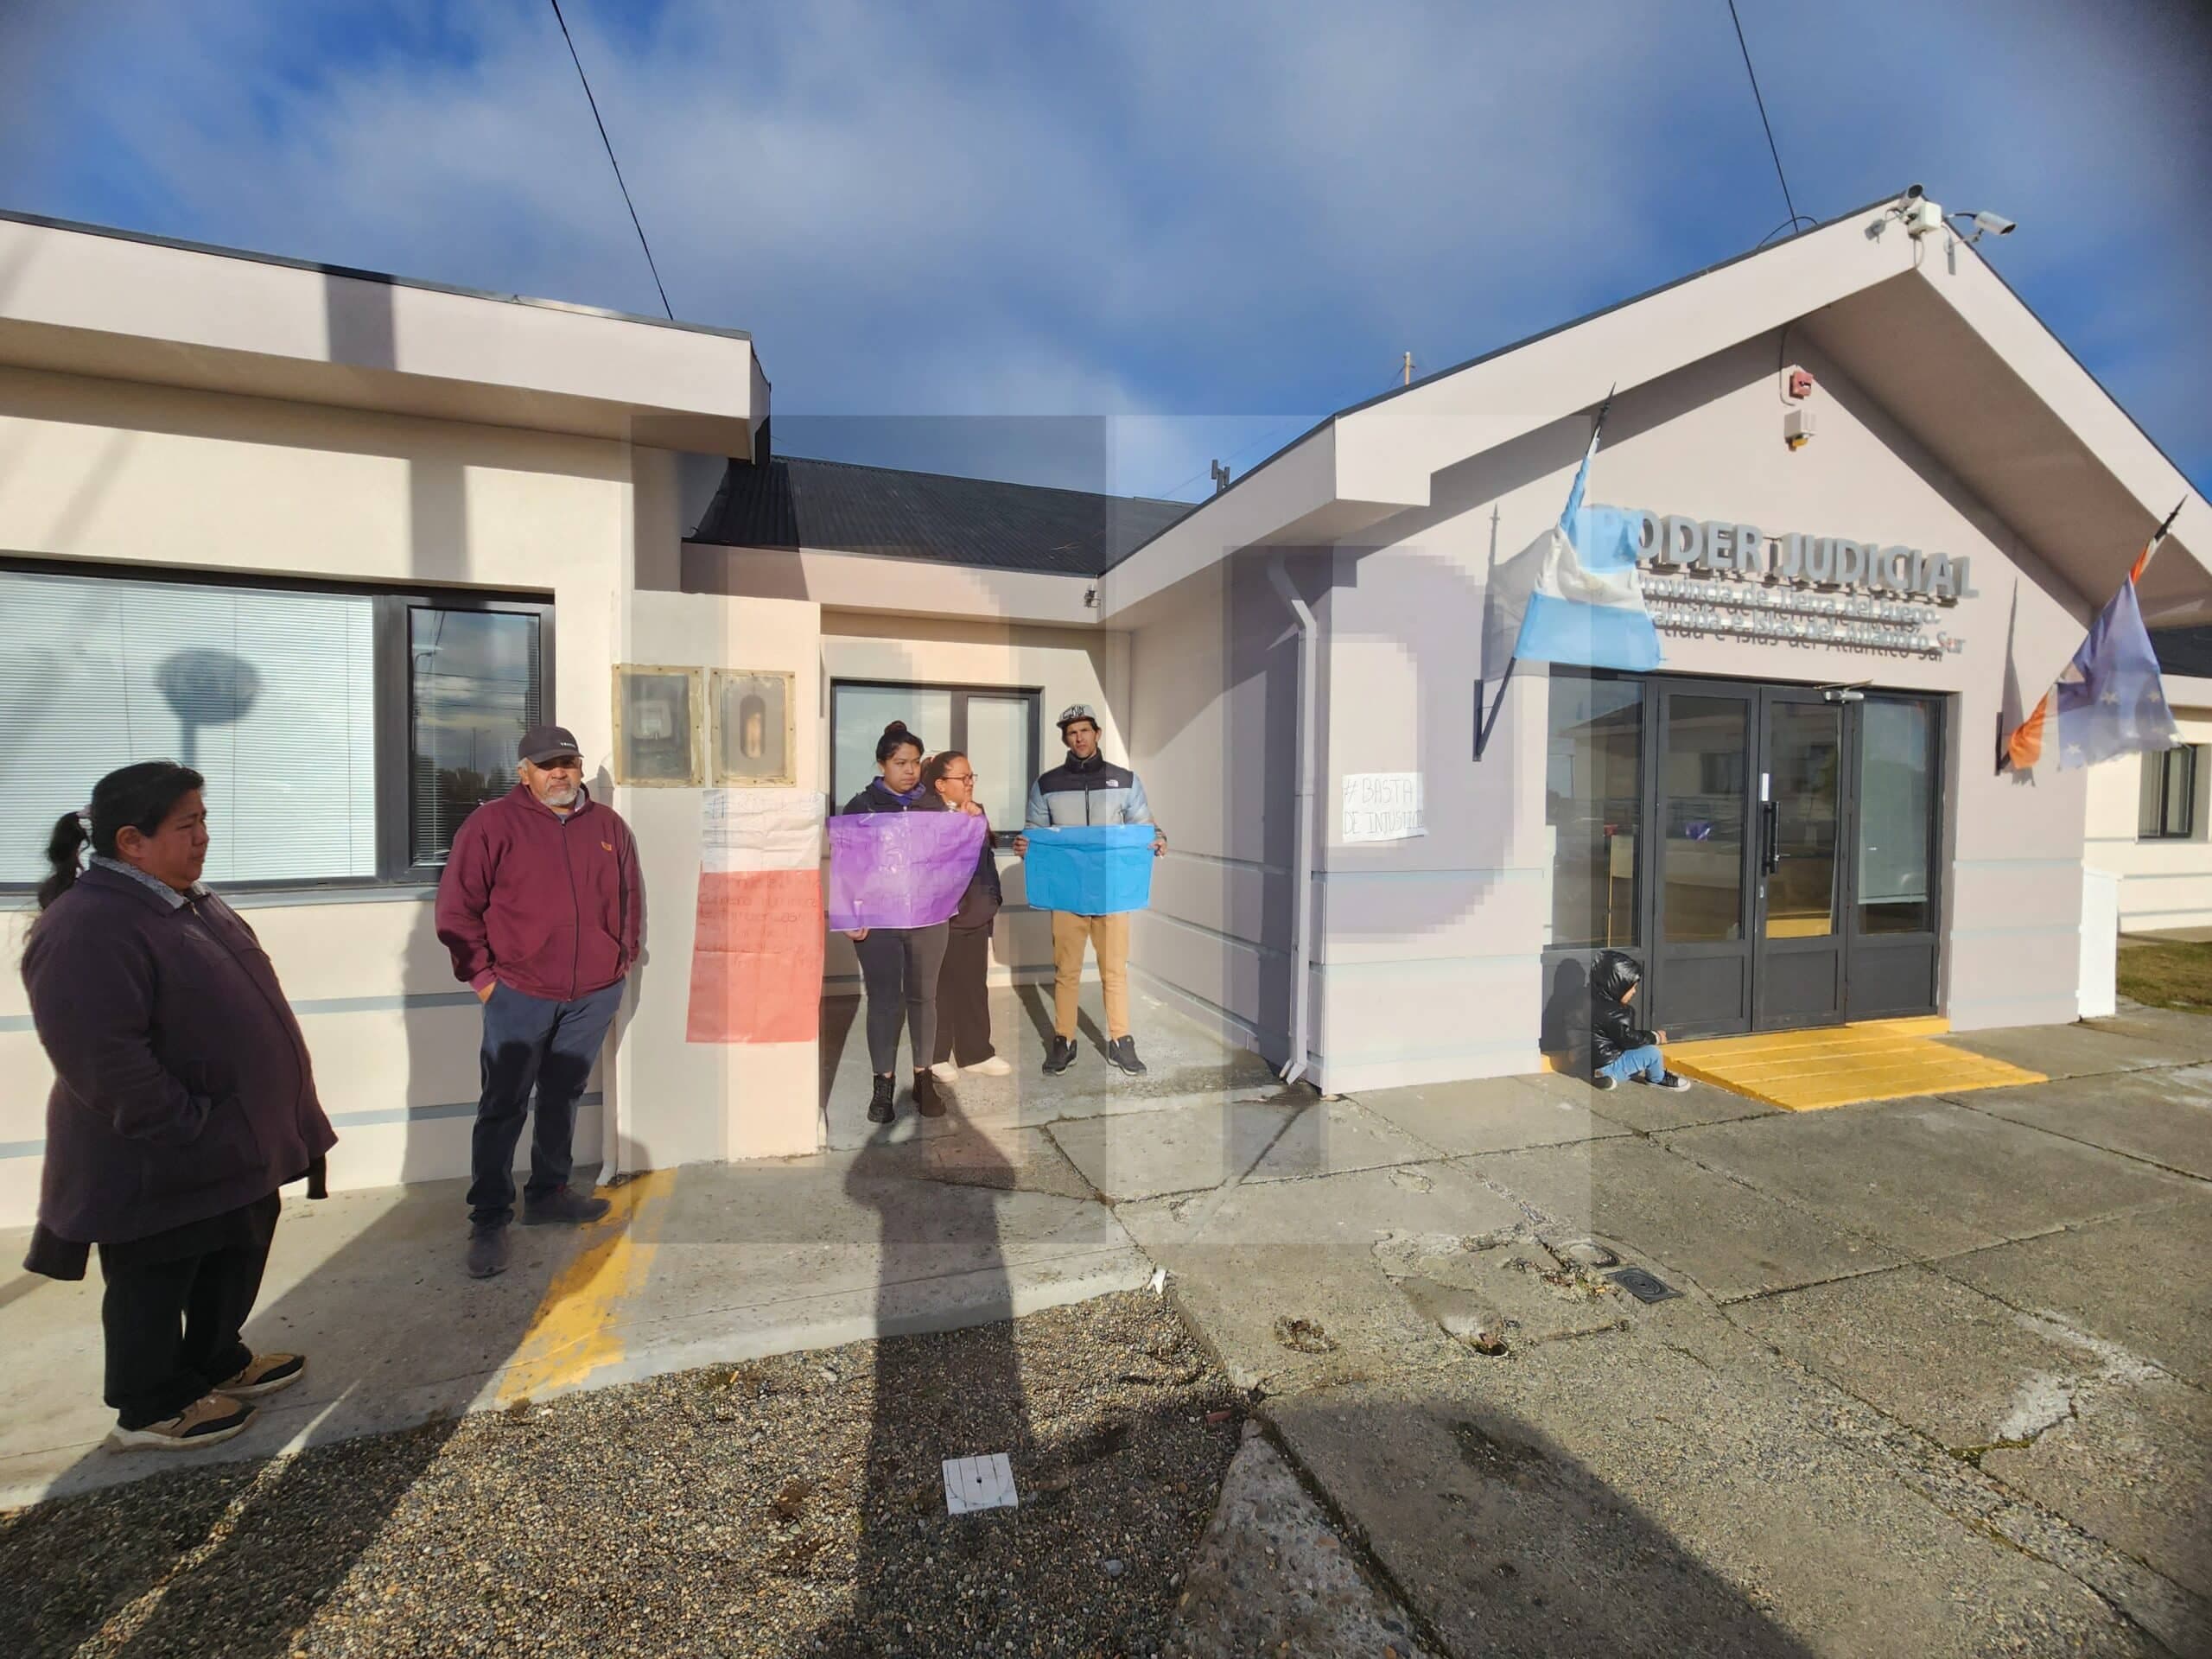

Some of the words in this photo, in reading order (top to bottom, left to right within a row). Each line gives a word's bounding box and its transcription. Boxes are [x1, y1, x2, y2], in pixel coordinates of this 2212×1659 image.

[1631, 508, 1764, 573] ODER
[1780, 532, 1979, 597] JUDICIAL
[1642, 573, 1733, 603] rovincia
[1742, 581, 1769, 606] de
[1777, 585, 1835, 614] Tierra
[1845, 592, 1873, 620] del
[1753, 609, 1798, 638] Islas
[1806, 614, 1834, 641] del
[1344, 810, 1360, 834] DE
